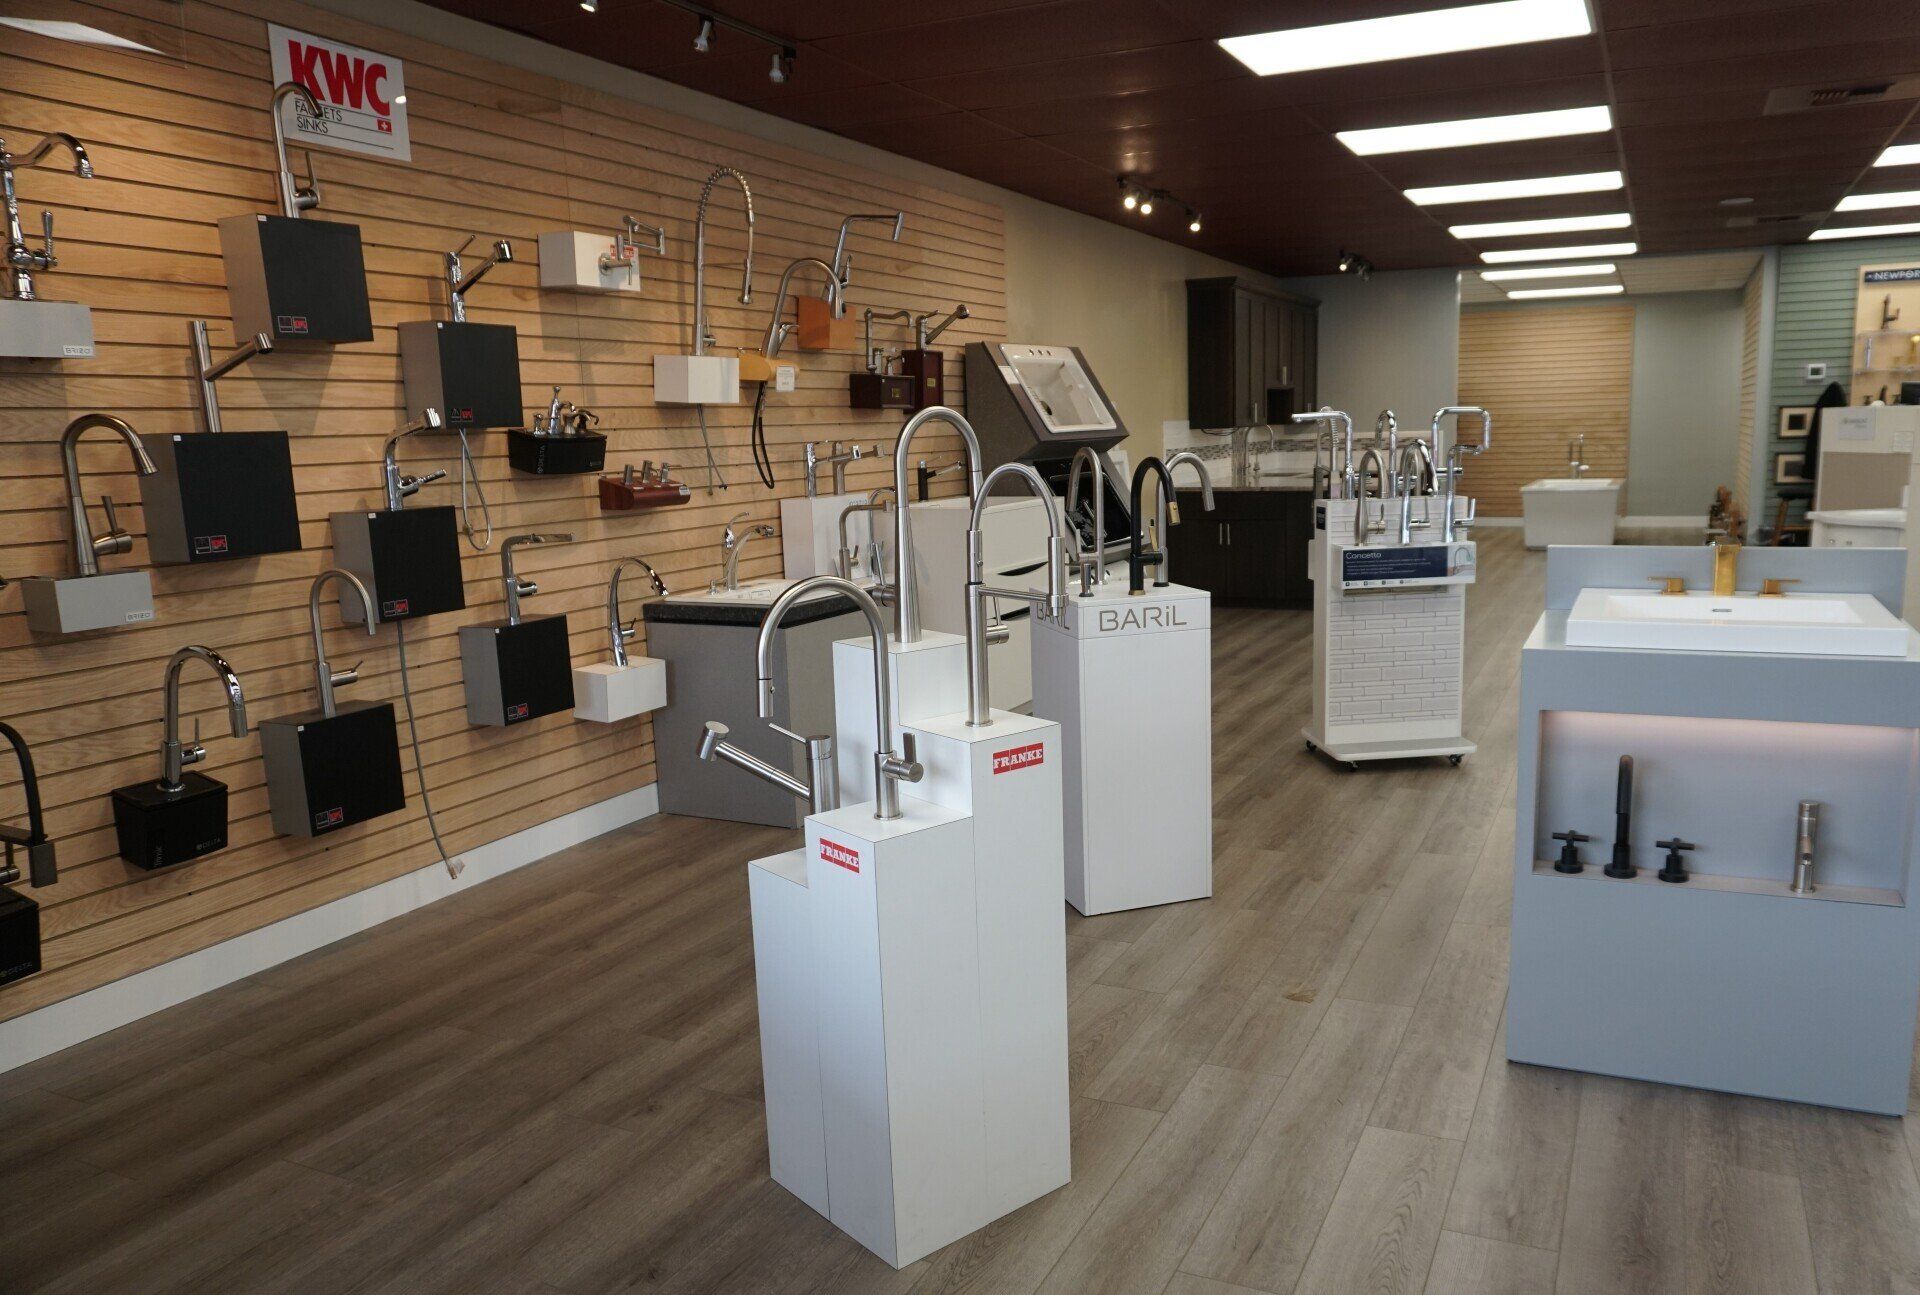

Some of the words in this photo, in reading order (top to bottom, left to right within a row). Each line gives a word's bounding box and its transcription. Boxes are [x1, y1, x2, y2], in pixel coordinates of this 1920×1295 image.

[288, 39, 391, 116] KWC
[295, 100, 343, 122] FAETS
[297, 116, 329, 134] SINKS
[1345, 552, 1382, 560] Concetto
[992, 748, 1043, 769] FRANKE
[820, 843, 860, 869] FRANKE
